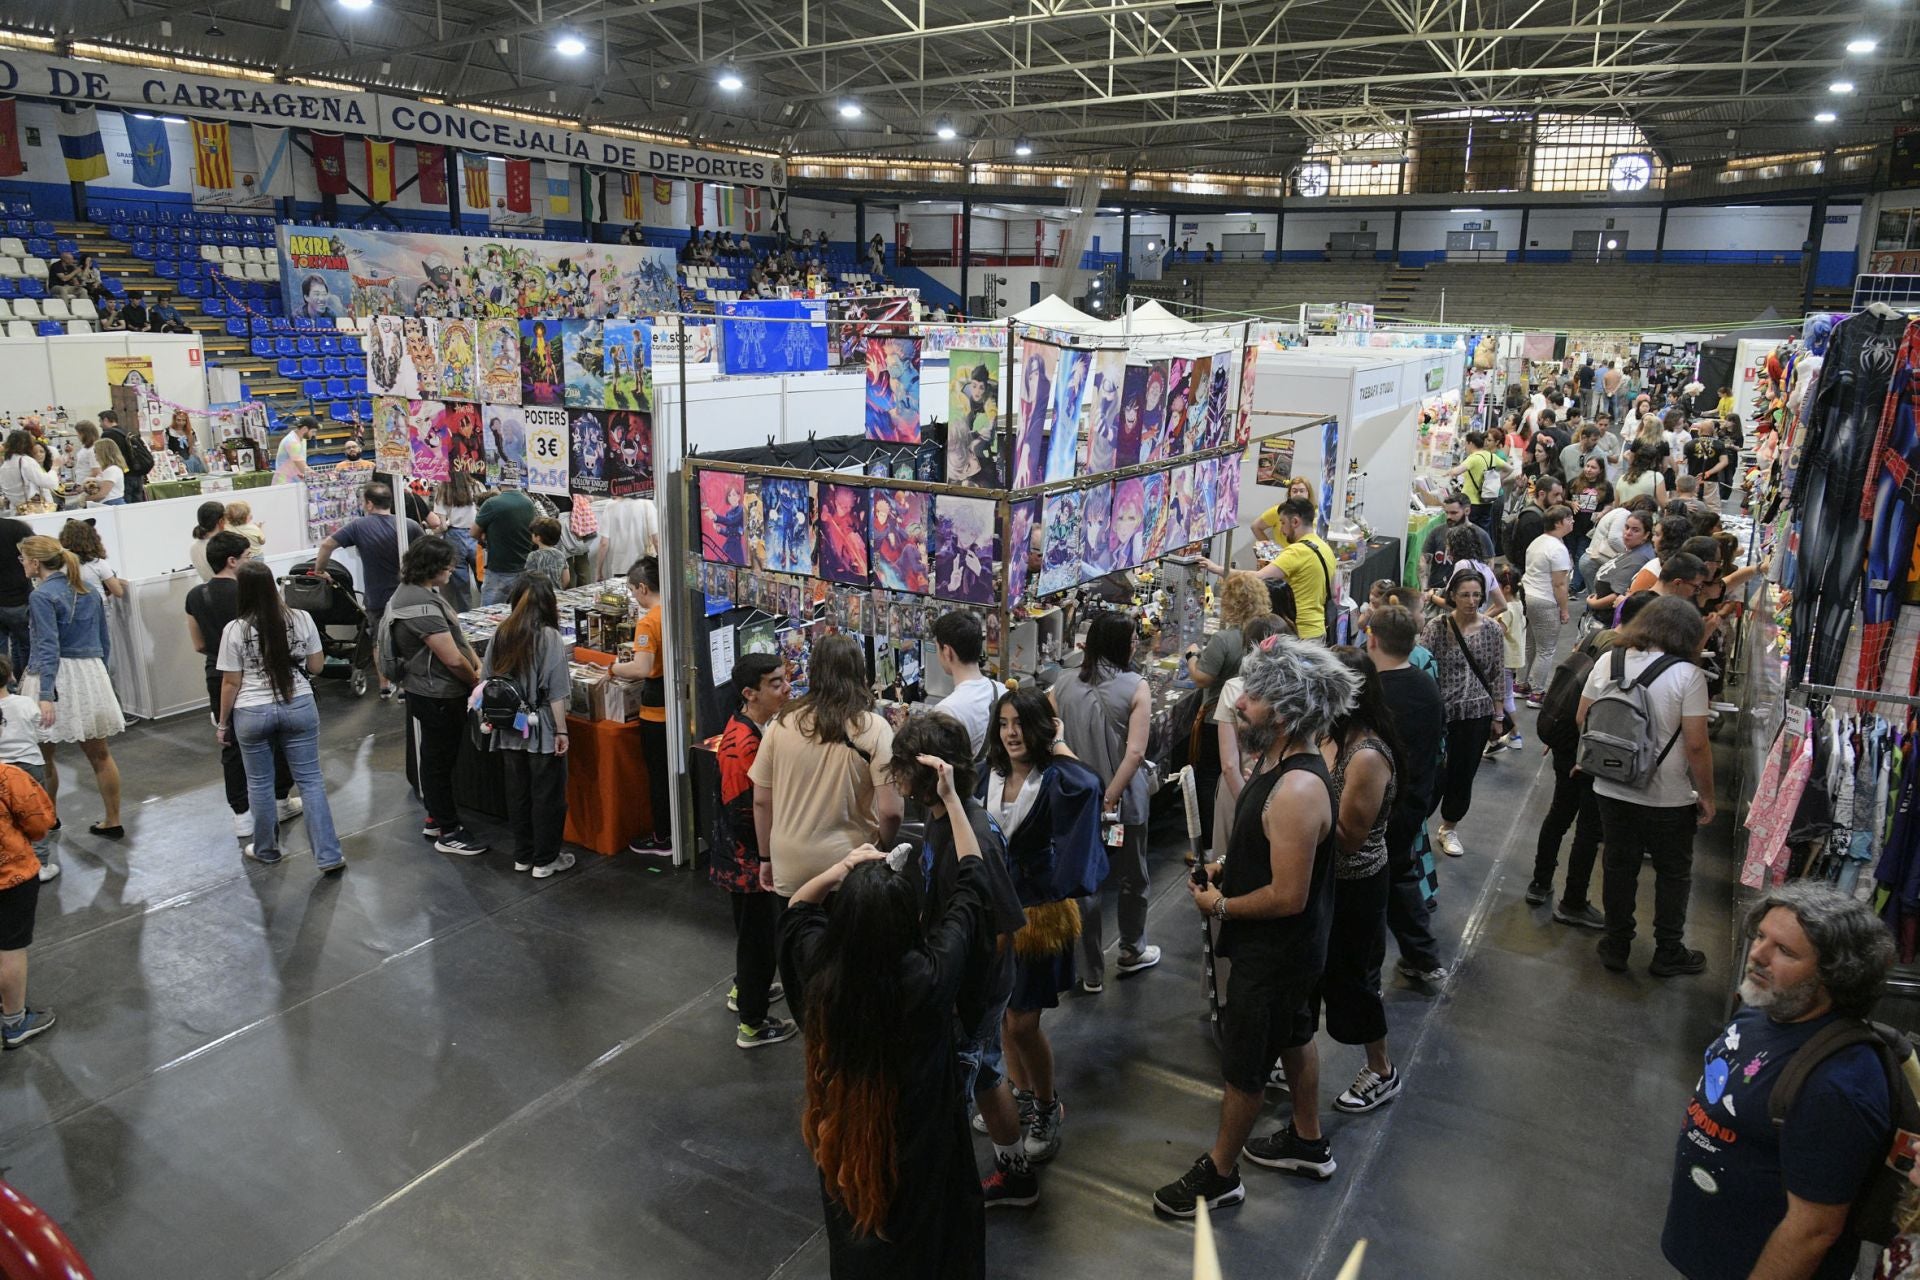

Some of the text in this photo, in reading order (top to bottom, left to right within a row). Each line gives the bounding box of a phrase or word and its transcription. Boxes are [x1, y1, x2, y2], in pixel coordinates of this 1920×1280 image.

[47, 67, 110, 100] DE
[143, 79, 366, 125] CARTAGENA
[392, 106, 764, 180] CONCEJALÍA DE DEPORTES
[290, 235, 331, 256] AKIRA
[291, 254, 349, 271] TORIYAMA
[524, 409, 566, 426] POSTERS
[537, 437, 558, 457] 3€
